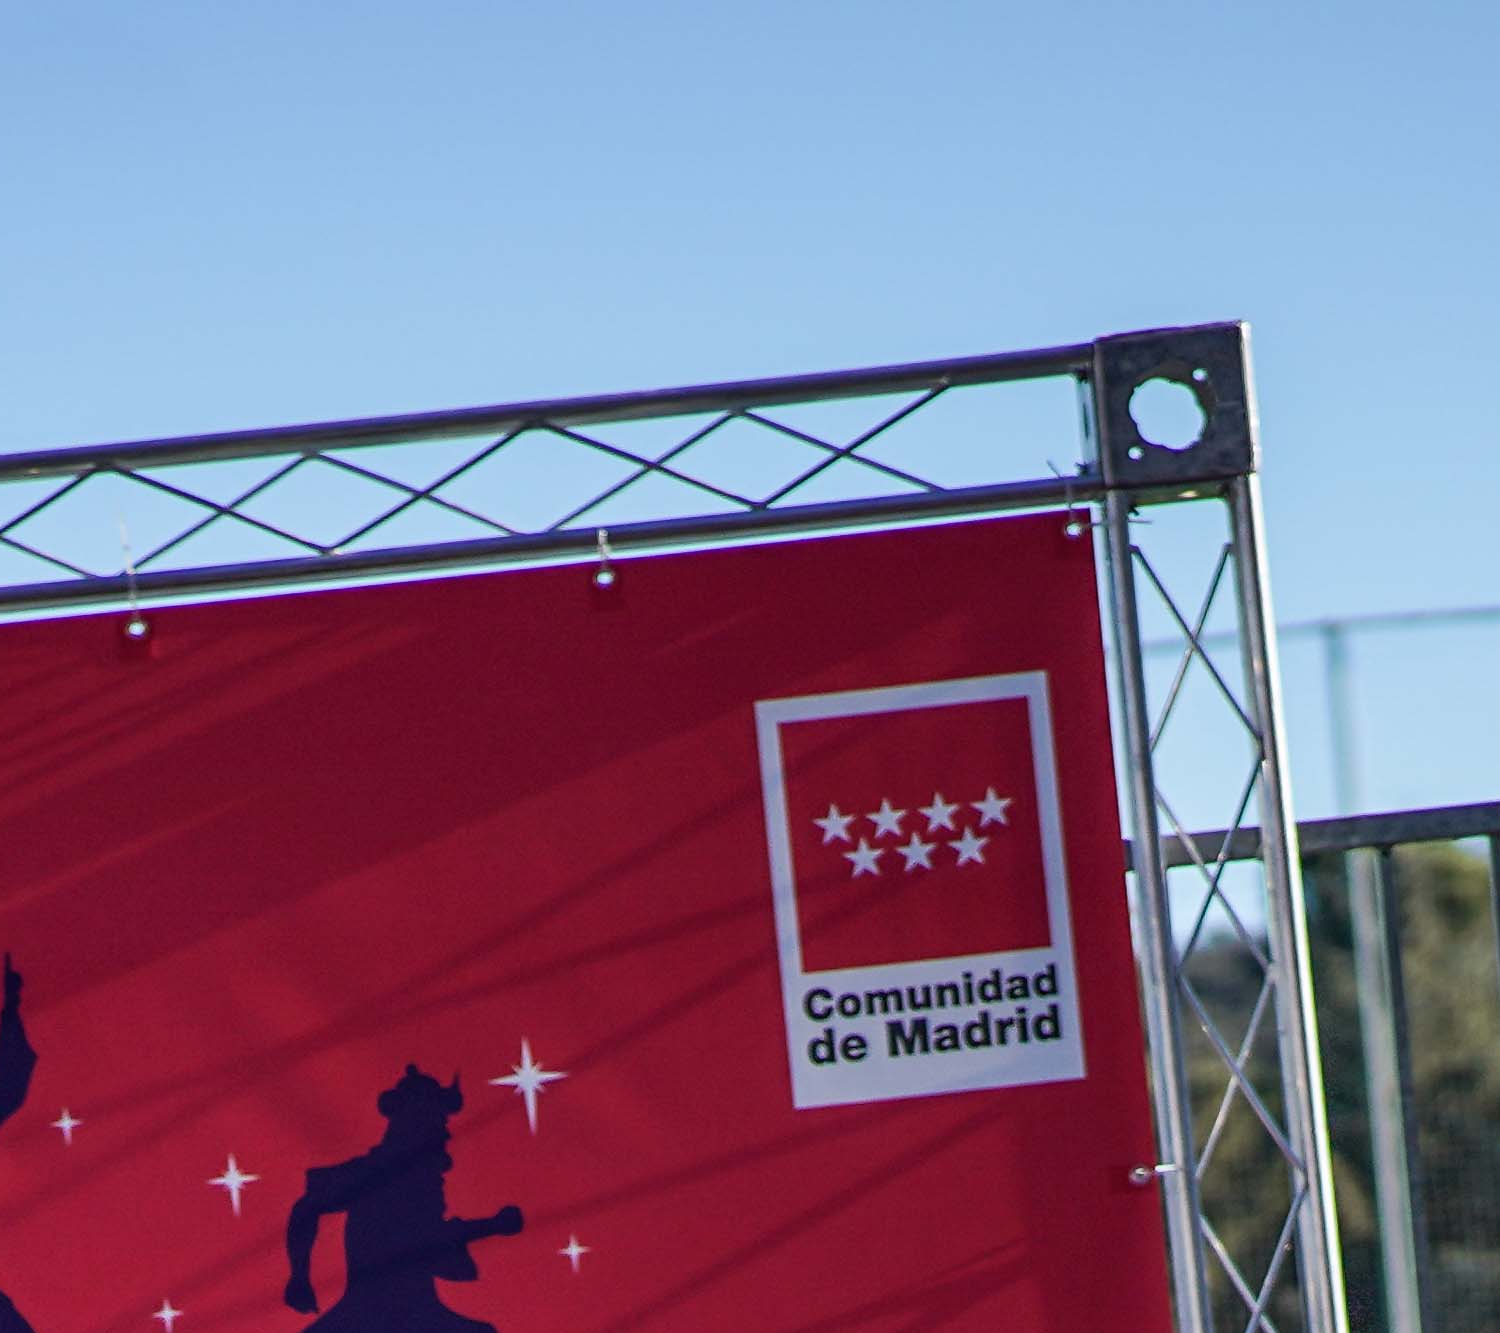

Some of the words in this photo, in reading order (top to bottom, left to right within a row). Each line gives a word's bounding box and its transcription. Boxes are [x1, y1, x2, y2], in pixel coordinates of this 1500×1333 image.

[802, 963, 1059, 1022] Comunidad
[807, 1029, 868, 1066] de
[886, 1004, 1062, 1058] Madrid
